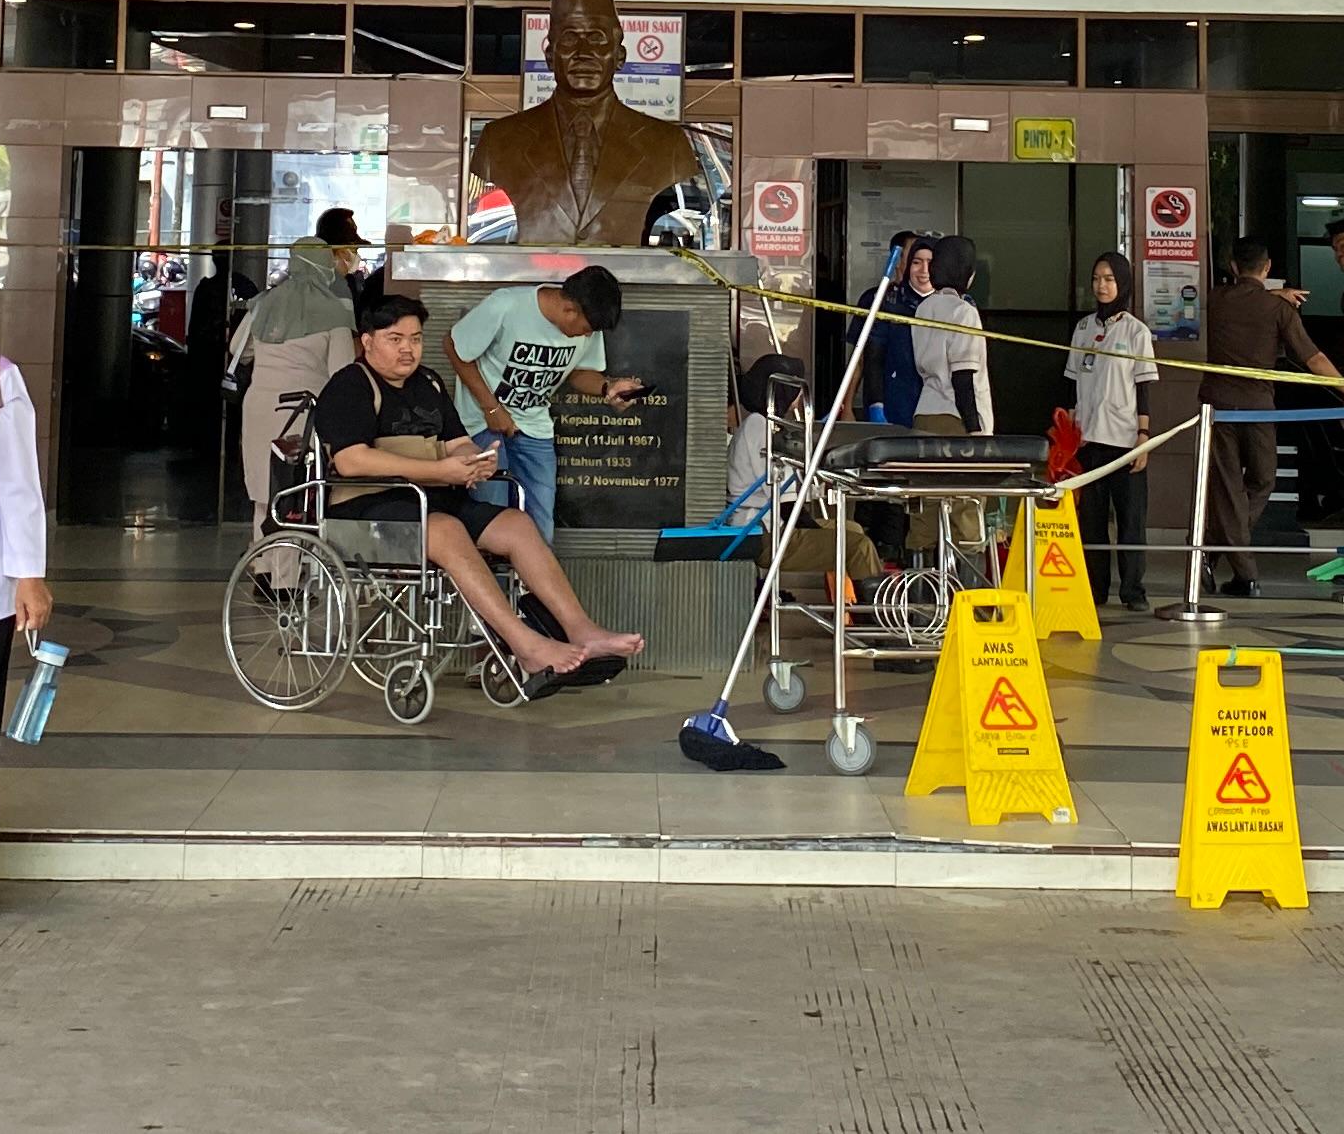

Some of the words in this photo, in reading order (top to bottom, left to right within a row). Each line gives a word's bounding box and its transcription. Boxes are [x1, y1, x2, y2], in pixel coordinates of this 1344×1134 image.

[651, 21, 680, 34] SAKIT
[1024, 129, 1052, 149] PINTU
[757, 225, 798, 233] KAWASAN
[1150, 230, 1192, 238] KAWASAN
[755, 235, 801, 243] DILARANG
[1148, 240, 1194, 248] DILARANG
[755, 243, 800, 251] MEROKOK
[1148, 249, 1193, 257] MEROKOK
[513, 344, 574, 366] CALVIN
[509, 368, 560, 390] KLEIN
[565, 394, 578, 404] 28
[642, 396, 668, 405] 1923
[560, 415, 599, 426] Kepala
[602, 415, 642, 426] Daerah
[570, 456, 602, 466] tahun
[606, 457, 632, 467] 1933
[578, 476, 590, 485] 12
[593, 476, 650, 486] November
[654, 477, 680, 486] 1977
[1036, 522, 1070, 531] CAUTION
[983, 642, 1014, 654] AWAS
[971, 657, 1003, 667] LANTAI
[1005, 657, 1029, 667] LICIN
[1217, 709, 1267, 721] CAUTION
[1211, 725, 1234, 736] WET
[1238, 725, 1274, 736] FLOOR
[1207, 821, 1228, 832] AWAS
[1229, 821, 1257, 832] LANTAI
[1258, 821, 1284, 832] BASAH
